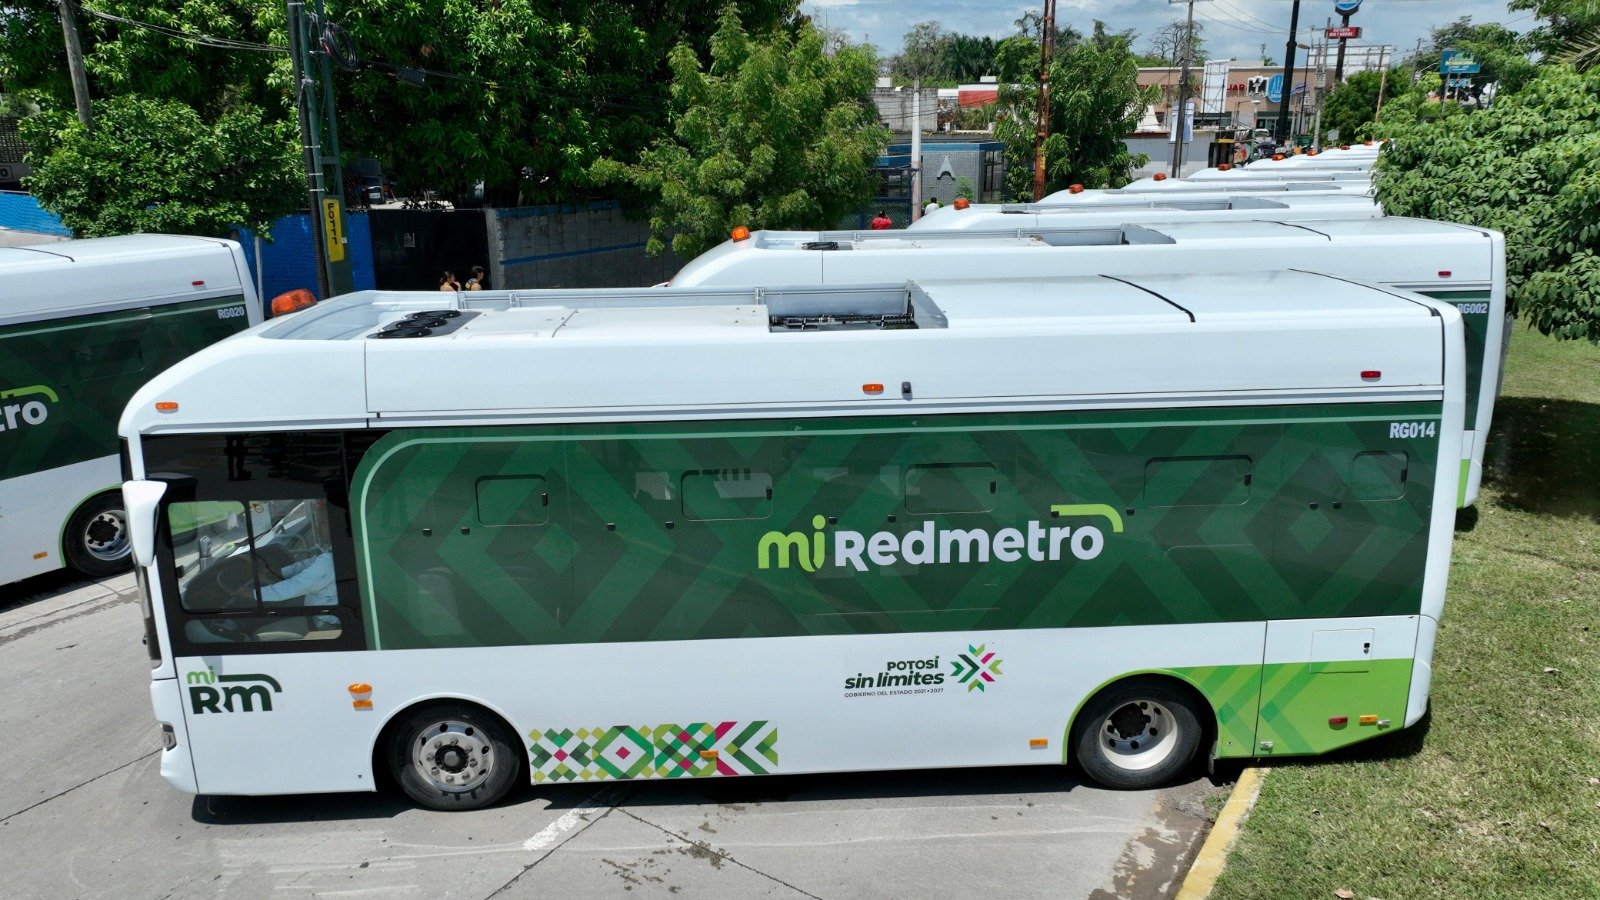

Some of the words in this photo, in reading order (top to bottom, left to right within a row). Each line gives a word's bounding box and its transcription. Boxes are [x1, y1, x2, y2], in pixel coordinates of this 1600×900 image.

[217, 305, 246, 320] RG020
[1456, 303, 1488, 315] RG002
[1389, 421, 1436, 439] RG014
[757, 514, 826, 573] mi
[834, 520, 1104, 572] Redmetro
[886, 655, 940, 671] POTOSÍ
[186, 665, 216, 685] mi
[844, 673, 875, 690] sin
